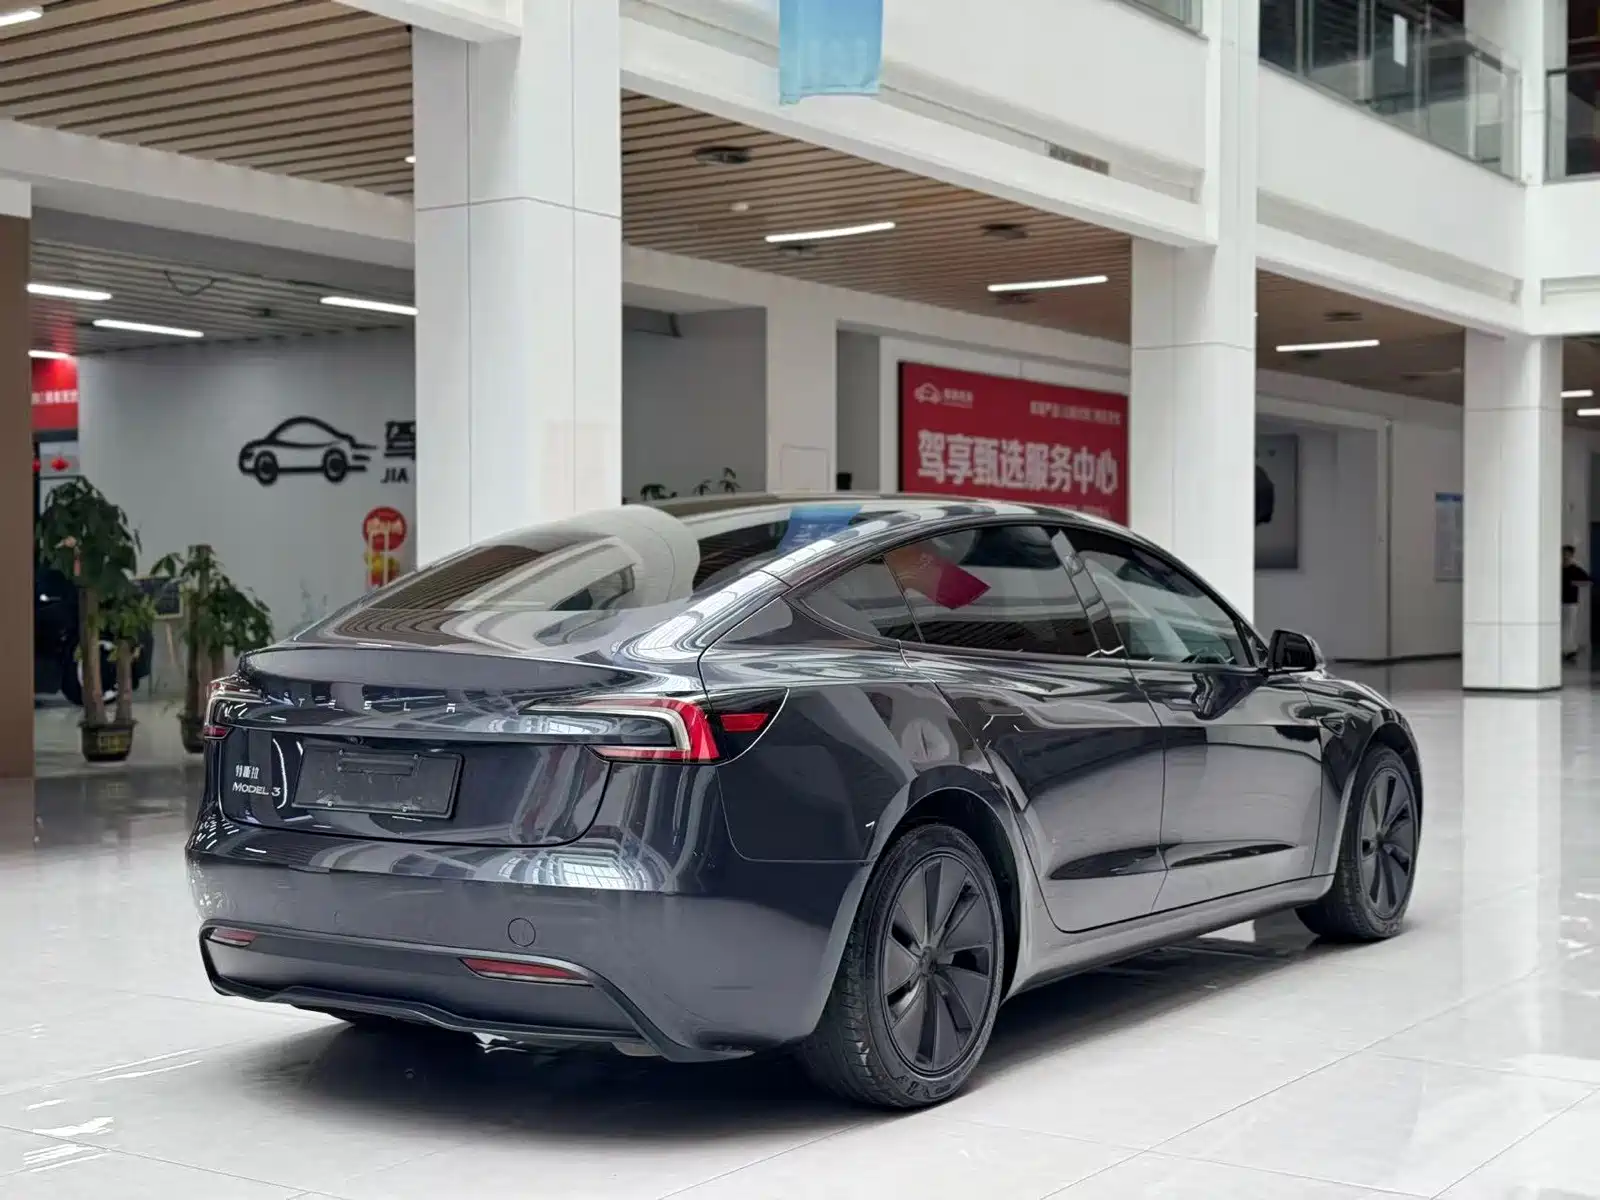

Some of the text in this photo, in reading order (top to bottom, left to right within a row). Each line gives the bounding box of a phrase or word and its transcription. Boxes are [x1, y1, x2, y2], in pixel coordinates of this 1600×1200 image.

[917, 429, 1119, 495] 驾享甄选服务中心
[380, 467, 409, 484] JIA
[232, 781, 281, 797] MODEL 3
